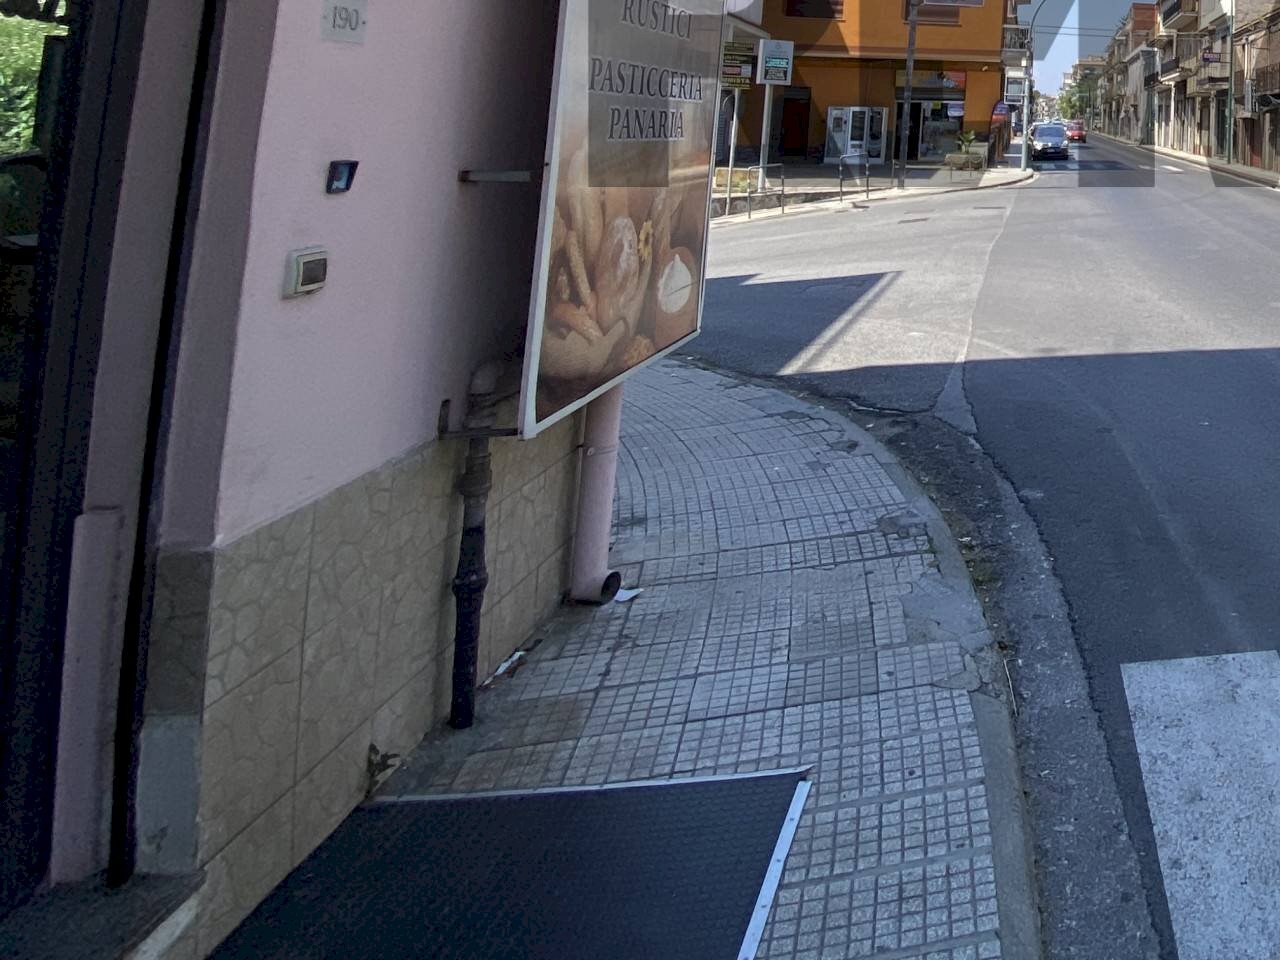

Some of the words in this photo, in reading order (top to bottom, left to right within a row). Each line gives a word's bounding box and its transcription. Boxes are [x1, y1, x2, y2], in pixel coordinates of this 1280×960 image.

[332, 5, 360, 31] 190
[589, 57, 703, 100] PASTICCERIA
[608, 107, 685, 140] PANARIA
